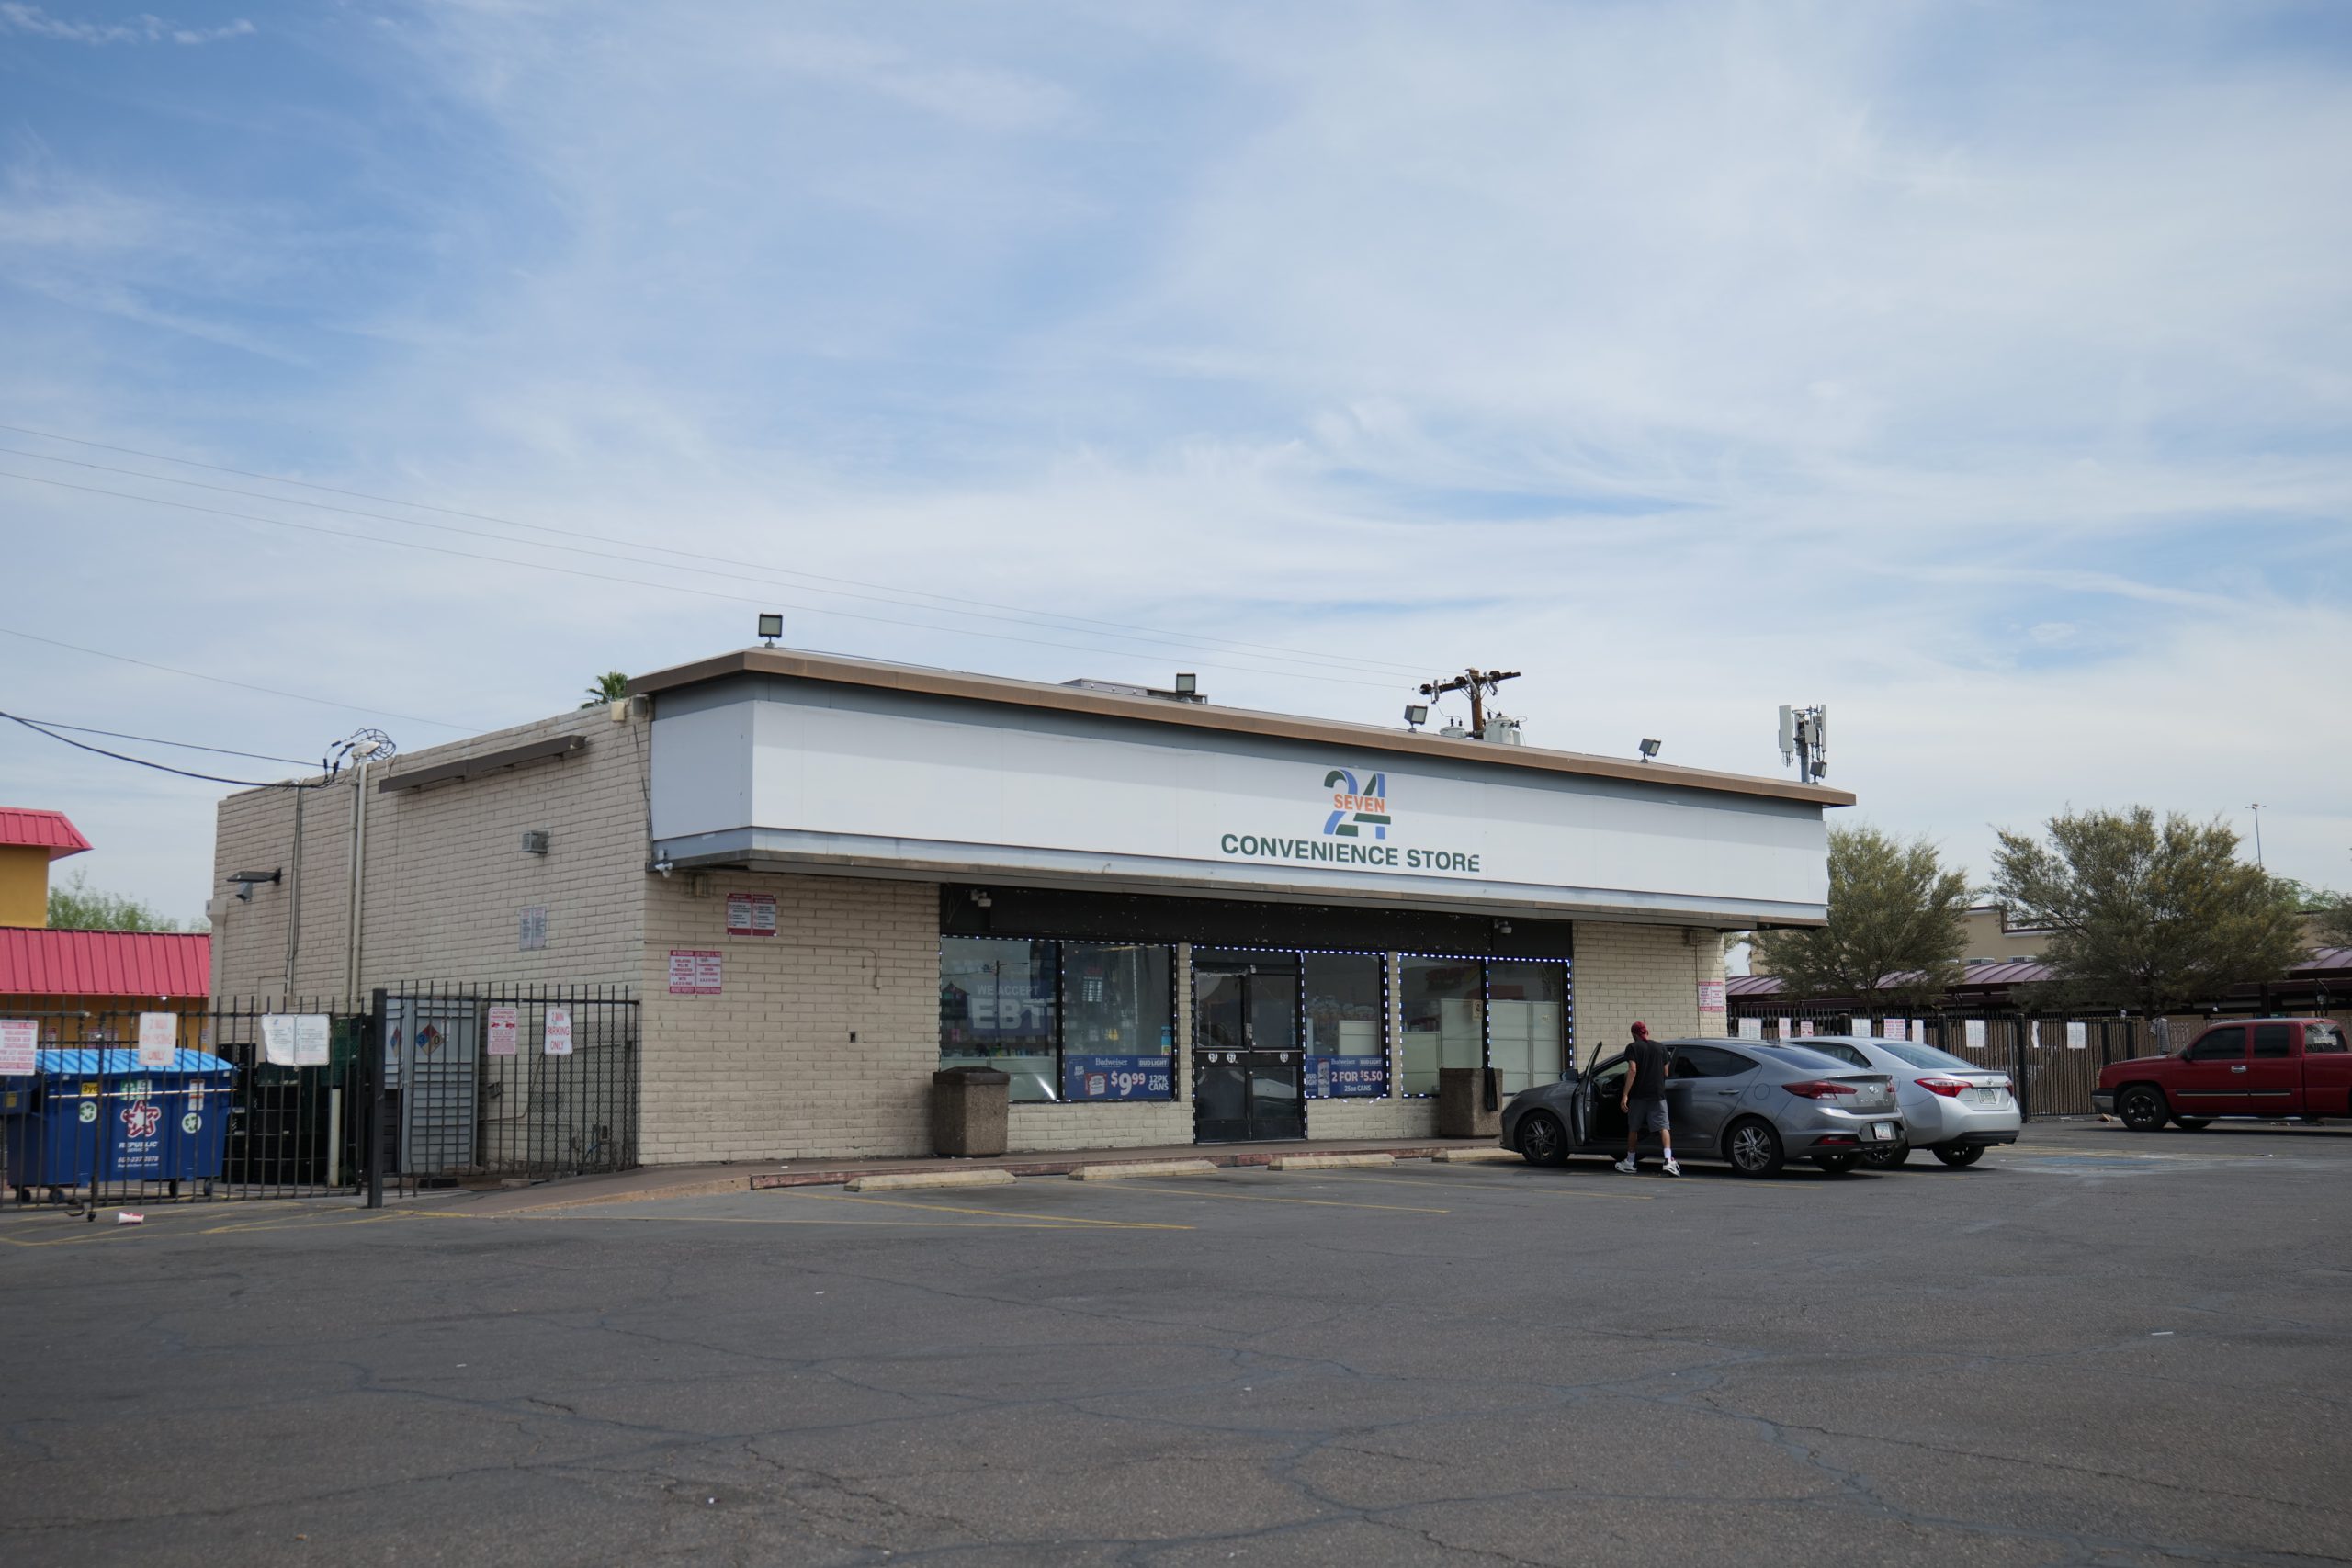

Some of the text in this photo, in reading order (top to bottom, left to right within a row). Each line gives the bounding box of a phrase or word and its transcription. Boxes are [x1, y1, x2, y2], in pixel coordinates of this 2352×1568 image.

[1323, 769, 1391, 840] 24
[1334, 793, 1385, 814] SEVEN
[1220, 833, 1480, 873] CONVENIENCE STORE
[977, 984, 1040, 997] WE ACCEPT
[971, 998, 1045, 1029] EBT
[547, 1025, 570, 1036] PARKING
[434, 1035, 440, 1045] 0
[550, 1039, 564, 1051] ONLY
[1095, 1057, 1128, 1066] Budweiser
[1148, 1075, 1169, 1084] 12PK
[1331, 1070, 1383, 1082] 2 FOR $5.50
[1148, 1083, 1170, 1091] CANS
